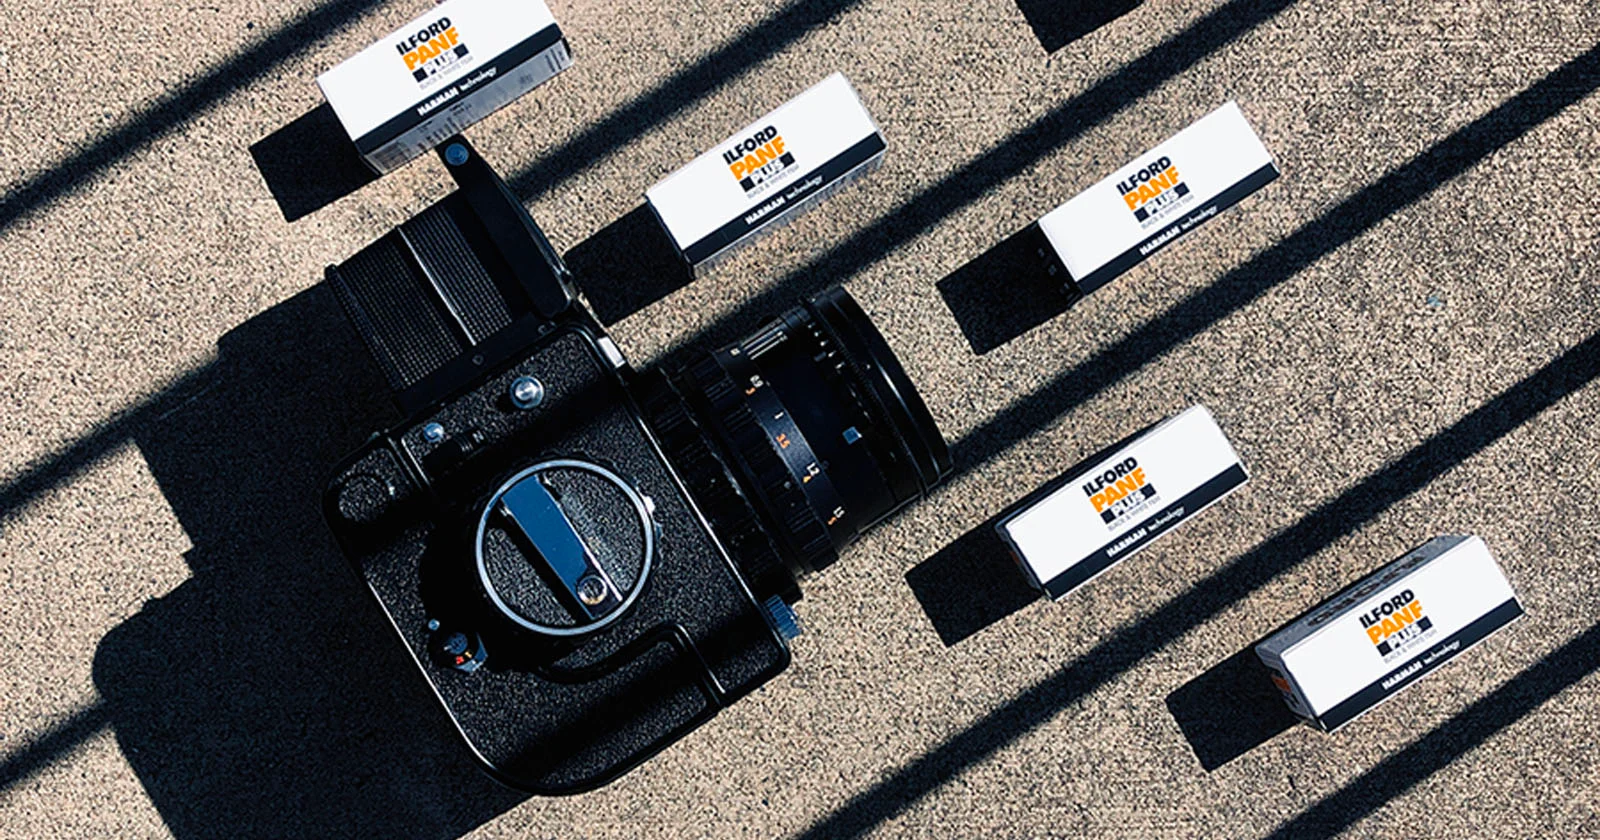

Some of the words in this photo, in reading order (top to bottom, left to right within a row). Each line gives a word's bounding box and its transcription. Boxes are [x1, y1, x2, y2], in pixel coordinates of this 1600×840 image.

[395, 17, 452, 56] ILFORD
[402, 26, 459, 71] PANF
[422, 49, 458, 76] PLUS
[416, 86, 460, 116] HARMAN
[459, 66, 497, 91] technology
[722, 125, 778, 165] ILFORD
[729, 135, 785, 181] PANF
[749, 157, 785, 185] PLUS
[1116, 156, 1172, 196] ILFORD
[1123, 165, 1179, 211] PANF
[744, 195, 786, 225] HARMAN
[785, 175, 823, 200] technology
[1143, 187, 1179, 216] PLUS
[1139, 225, 1181, 256] HARMAN
[1180, 205, 1218, 230] technology
[1082, 456, 1138, 497] ILFORD
[1089, 467, 1146, 513] PANF
[1110, 489, 1146, 517] PLUS
[1106, 527, 1148, 558] HARMAN
[1147, 506, 1185, 532] technology
[1359, 589, 1415, 629] ILFORD
[1366, 599, 1423, 645] PANF
[1386, 622, 1422, 650] PLUS
[1381, 660, 1423, 690] HARMAN
[1423, 640, 1460, 665] technology
